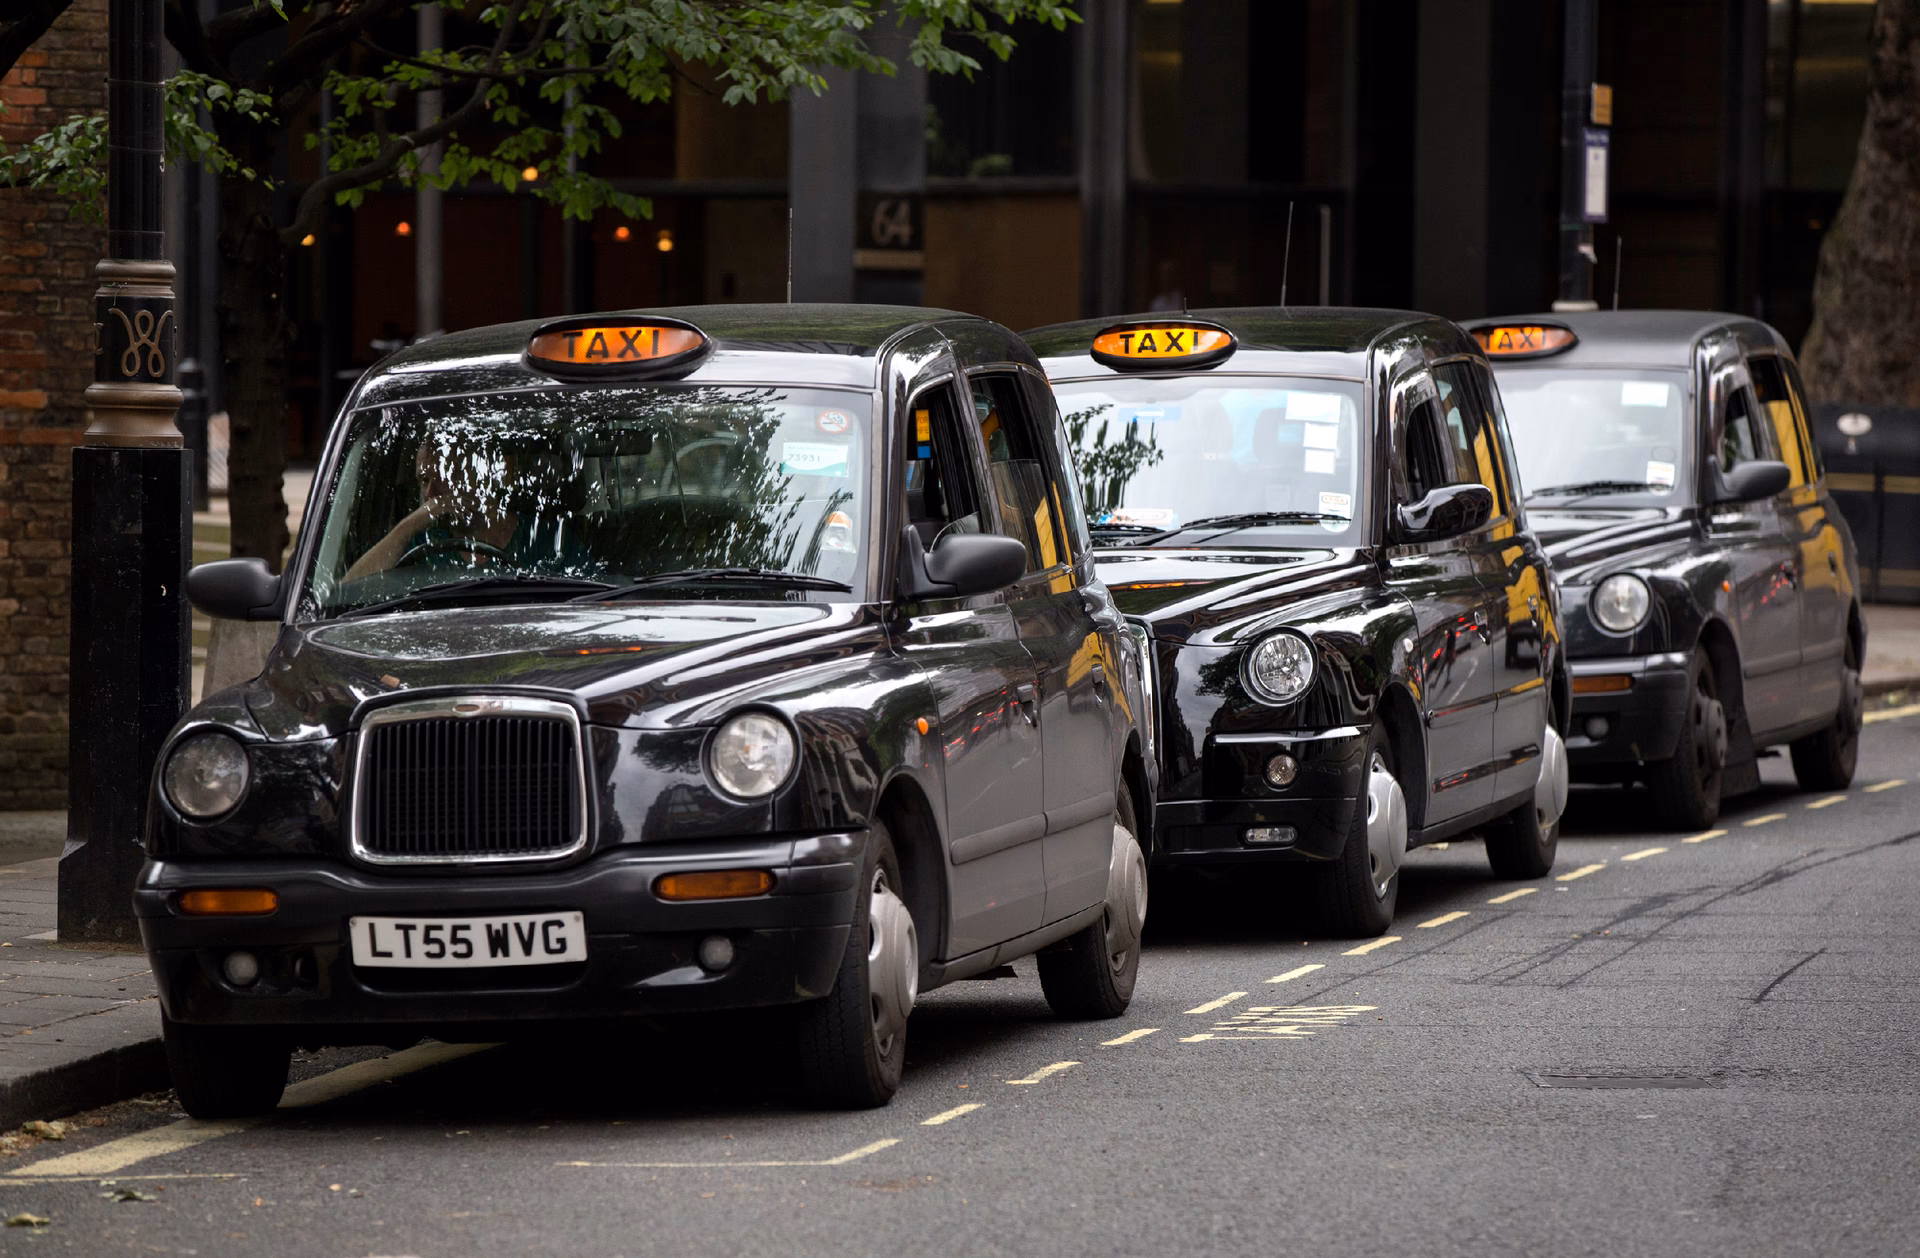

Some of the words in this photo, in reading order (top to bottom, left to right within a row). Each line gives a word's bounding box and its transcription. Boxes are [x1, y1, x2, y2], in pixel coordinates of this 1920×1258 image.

[872, 199, 912, 246] 64
[562, 329, 660, 359] TAXI
[1119, 331, 1199, 355] TAXI
[1482, 327, 1547, 350] TAXI
[788, 453, 820, 462] 73931
[367, 922, 474, 960] LT55
[485, 920, 568, 958] WVG
